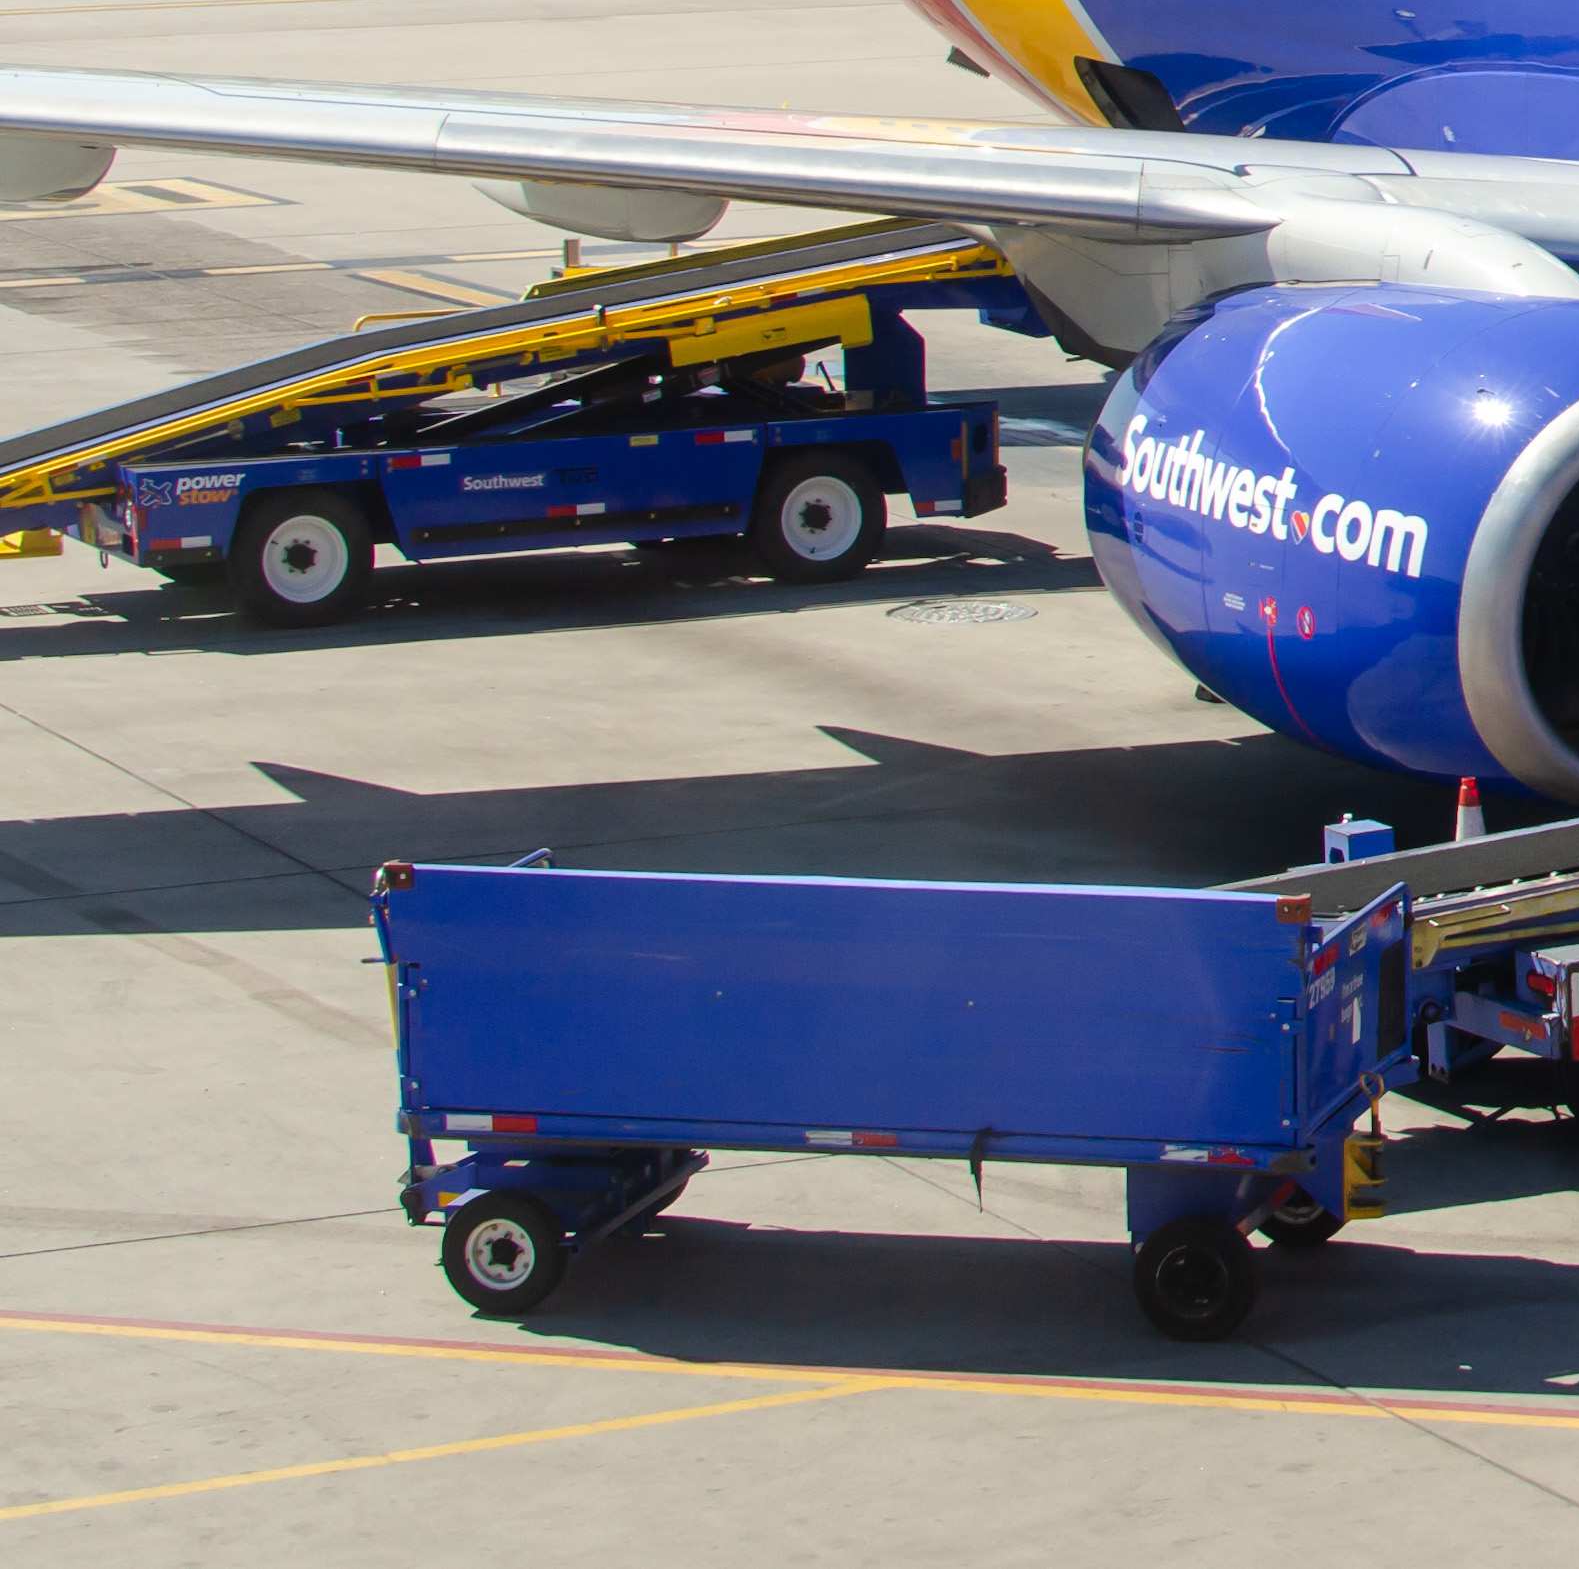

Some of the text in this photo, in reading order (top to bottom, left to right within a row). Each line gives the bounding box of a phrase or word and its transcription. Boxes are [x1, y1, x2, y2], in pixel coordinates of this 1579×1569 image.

[176, 472, 247, 496] power
[463, 473, 545, 491] Southwest
[178, 487, 232, 506] stow
